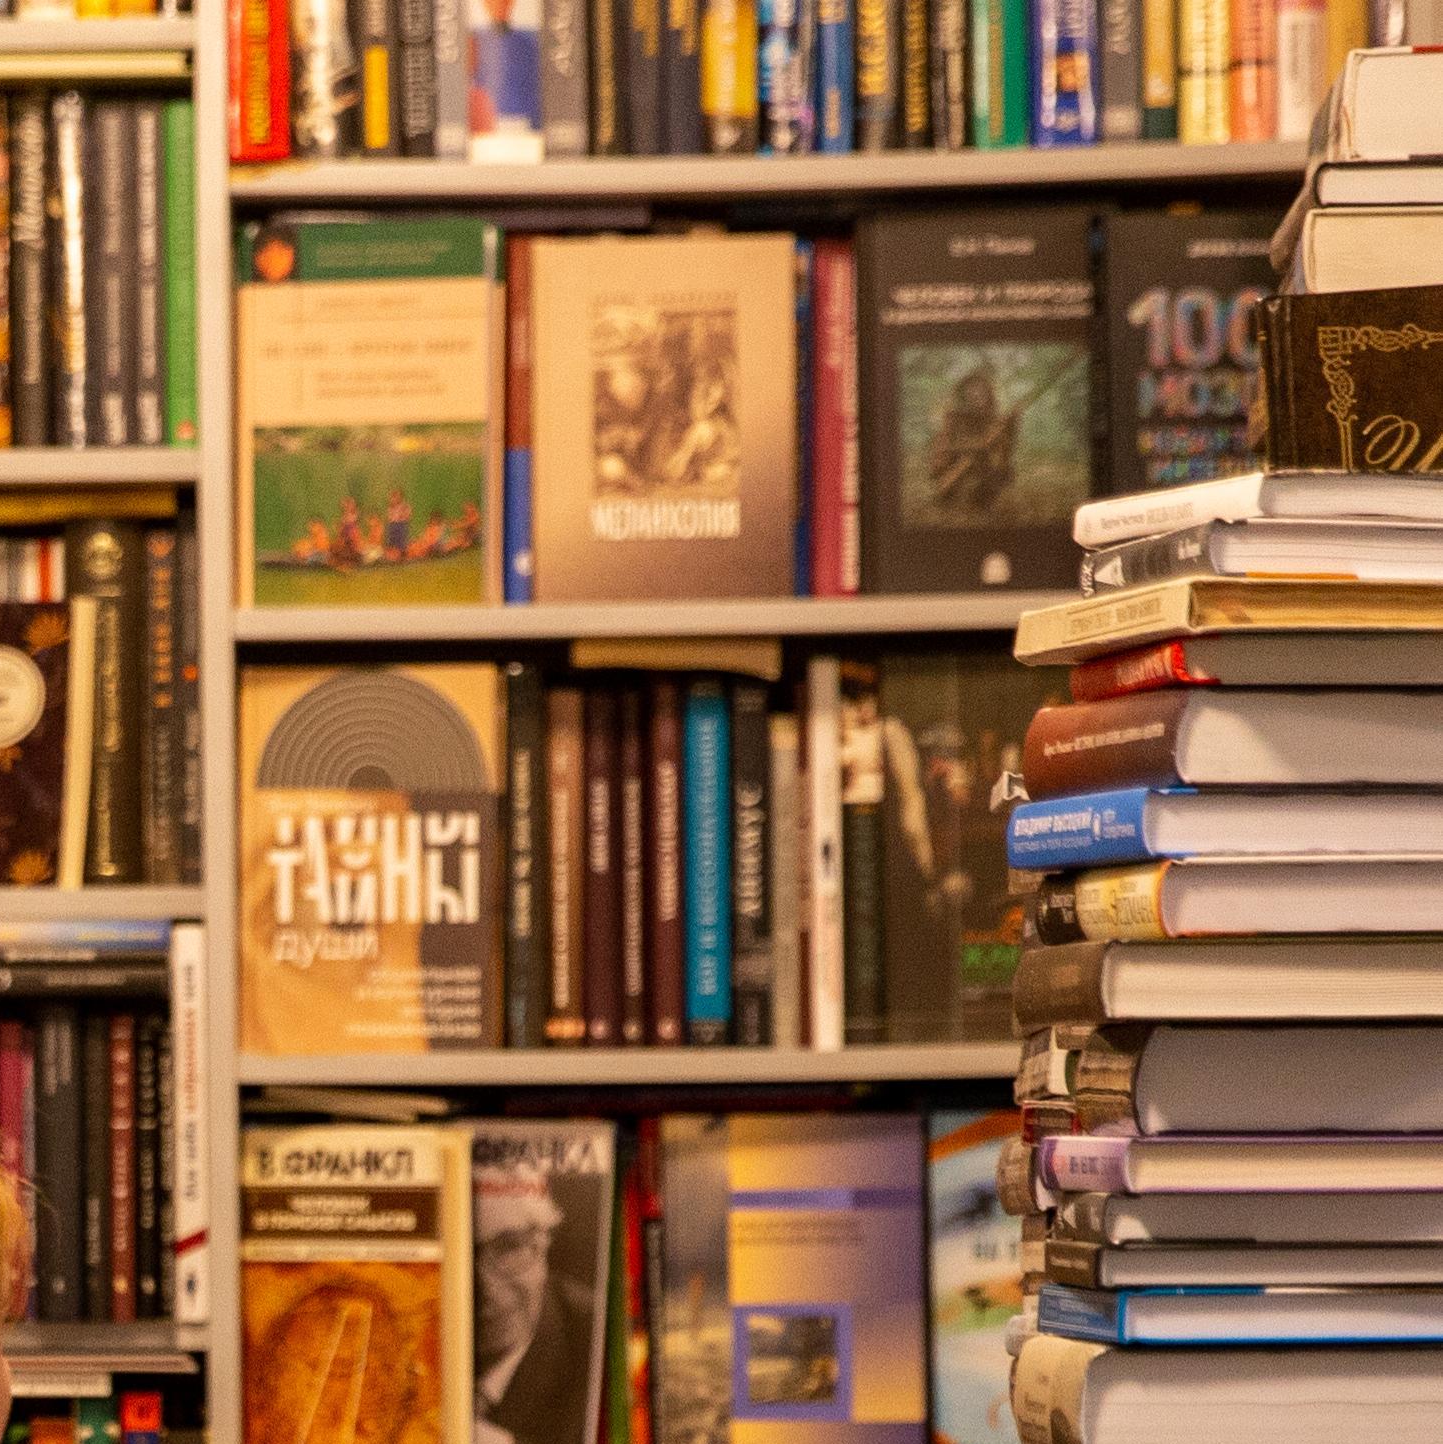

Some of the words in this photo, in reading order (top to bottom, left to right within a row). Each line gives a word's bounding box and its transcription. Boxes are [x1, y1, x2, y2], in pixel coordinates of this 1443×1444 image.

[267, 810, 481, 925] ТАЙНЫ
[272, 930, 379, 969] души
[284, 1149, 415, 1177] ФРАНКЛ
